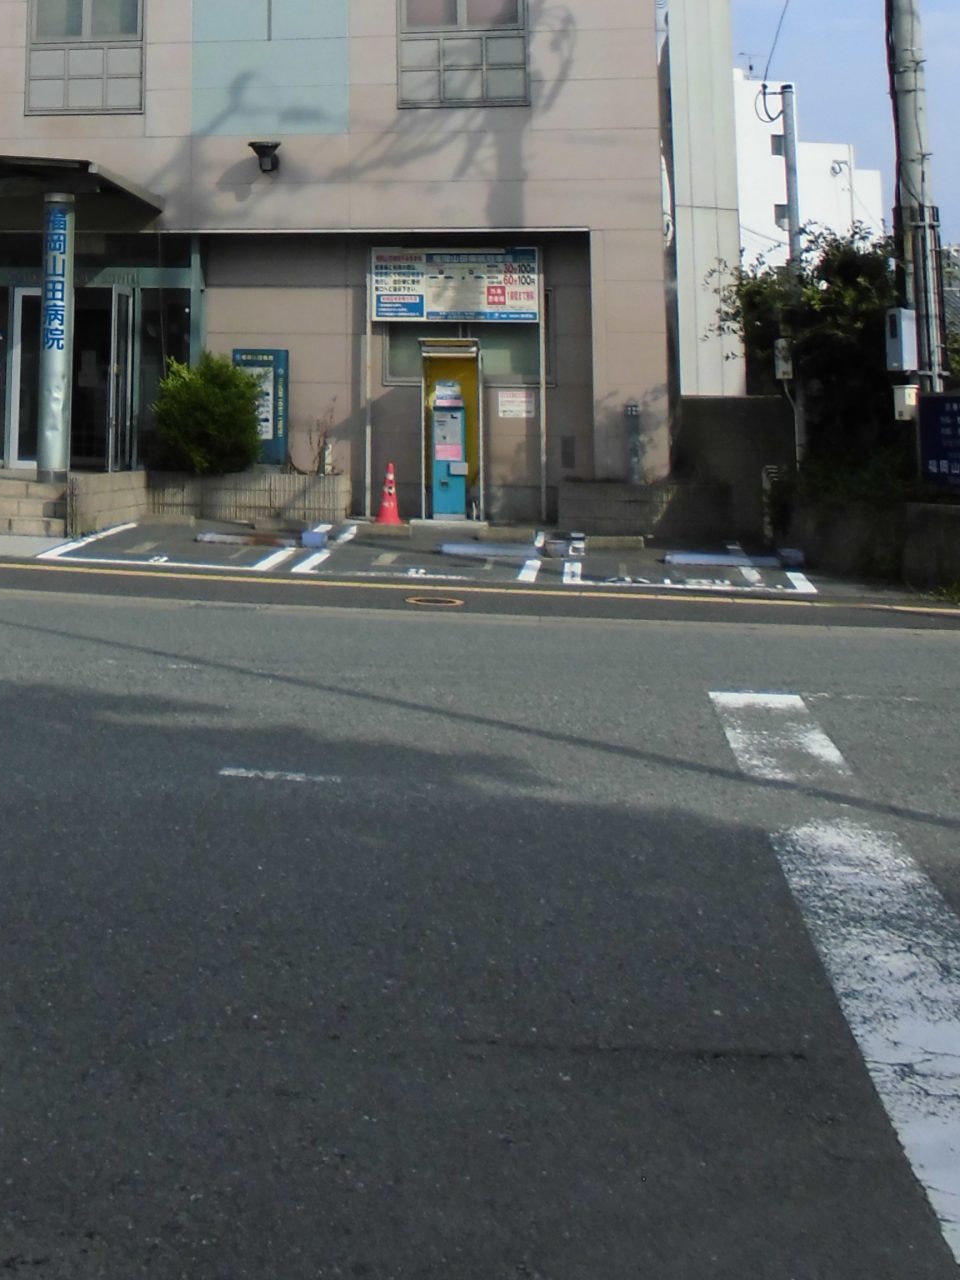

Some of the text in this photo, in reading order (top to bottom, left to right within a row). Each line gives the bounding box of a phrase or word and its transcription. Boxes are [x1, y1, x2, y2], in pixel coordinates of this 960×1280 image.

[43, 207, 67, 351] 福岡山田病院
